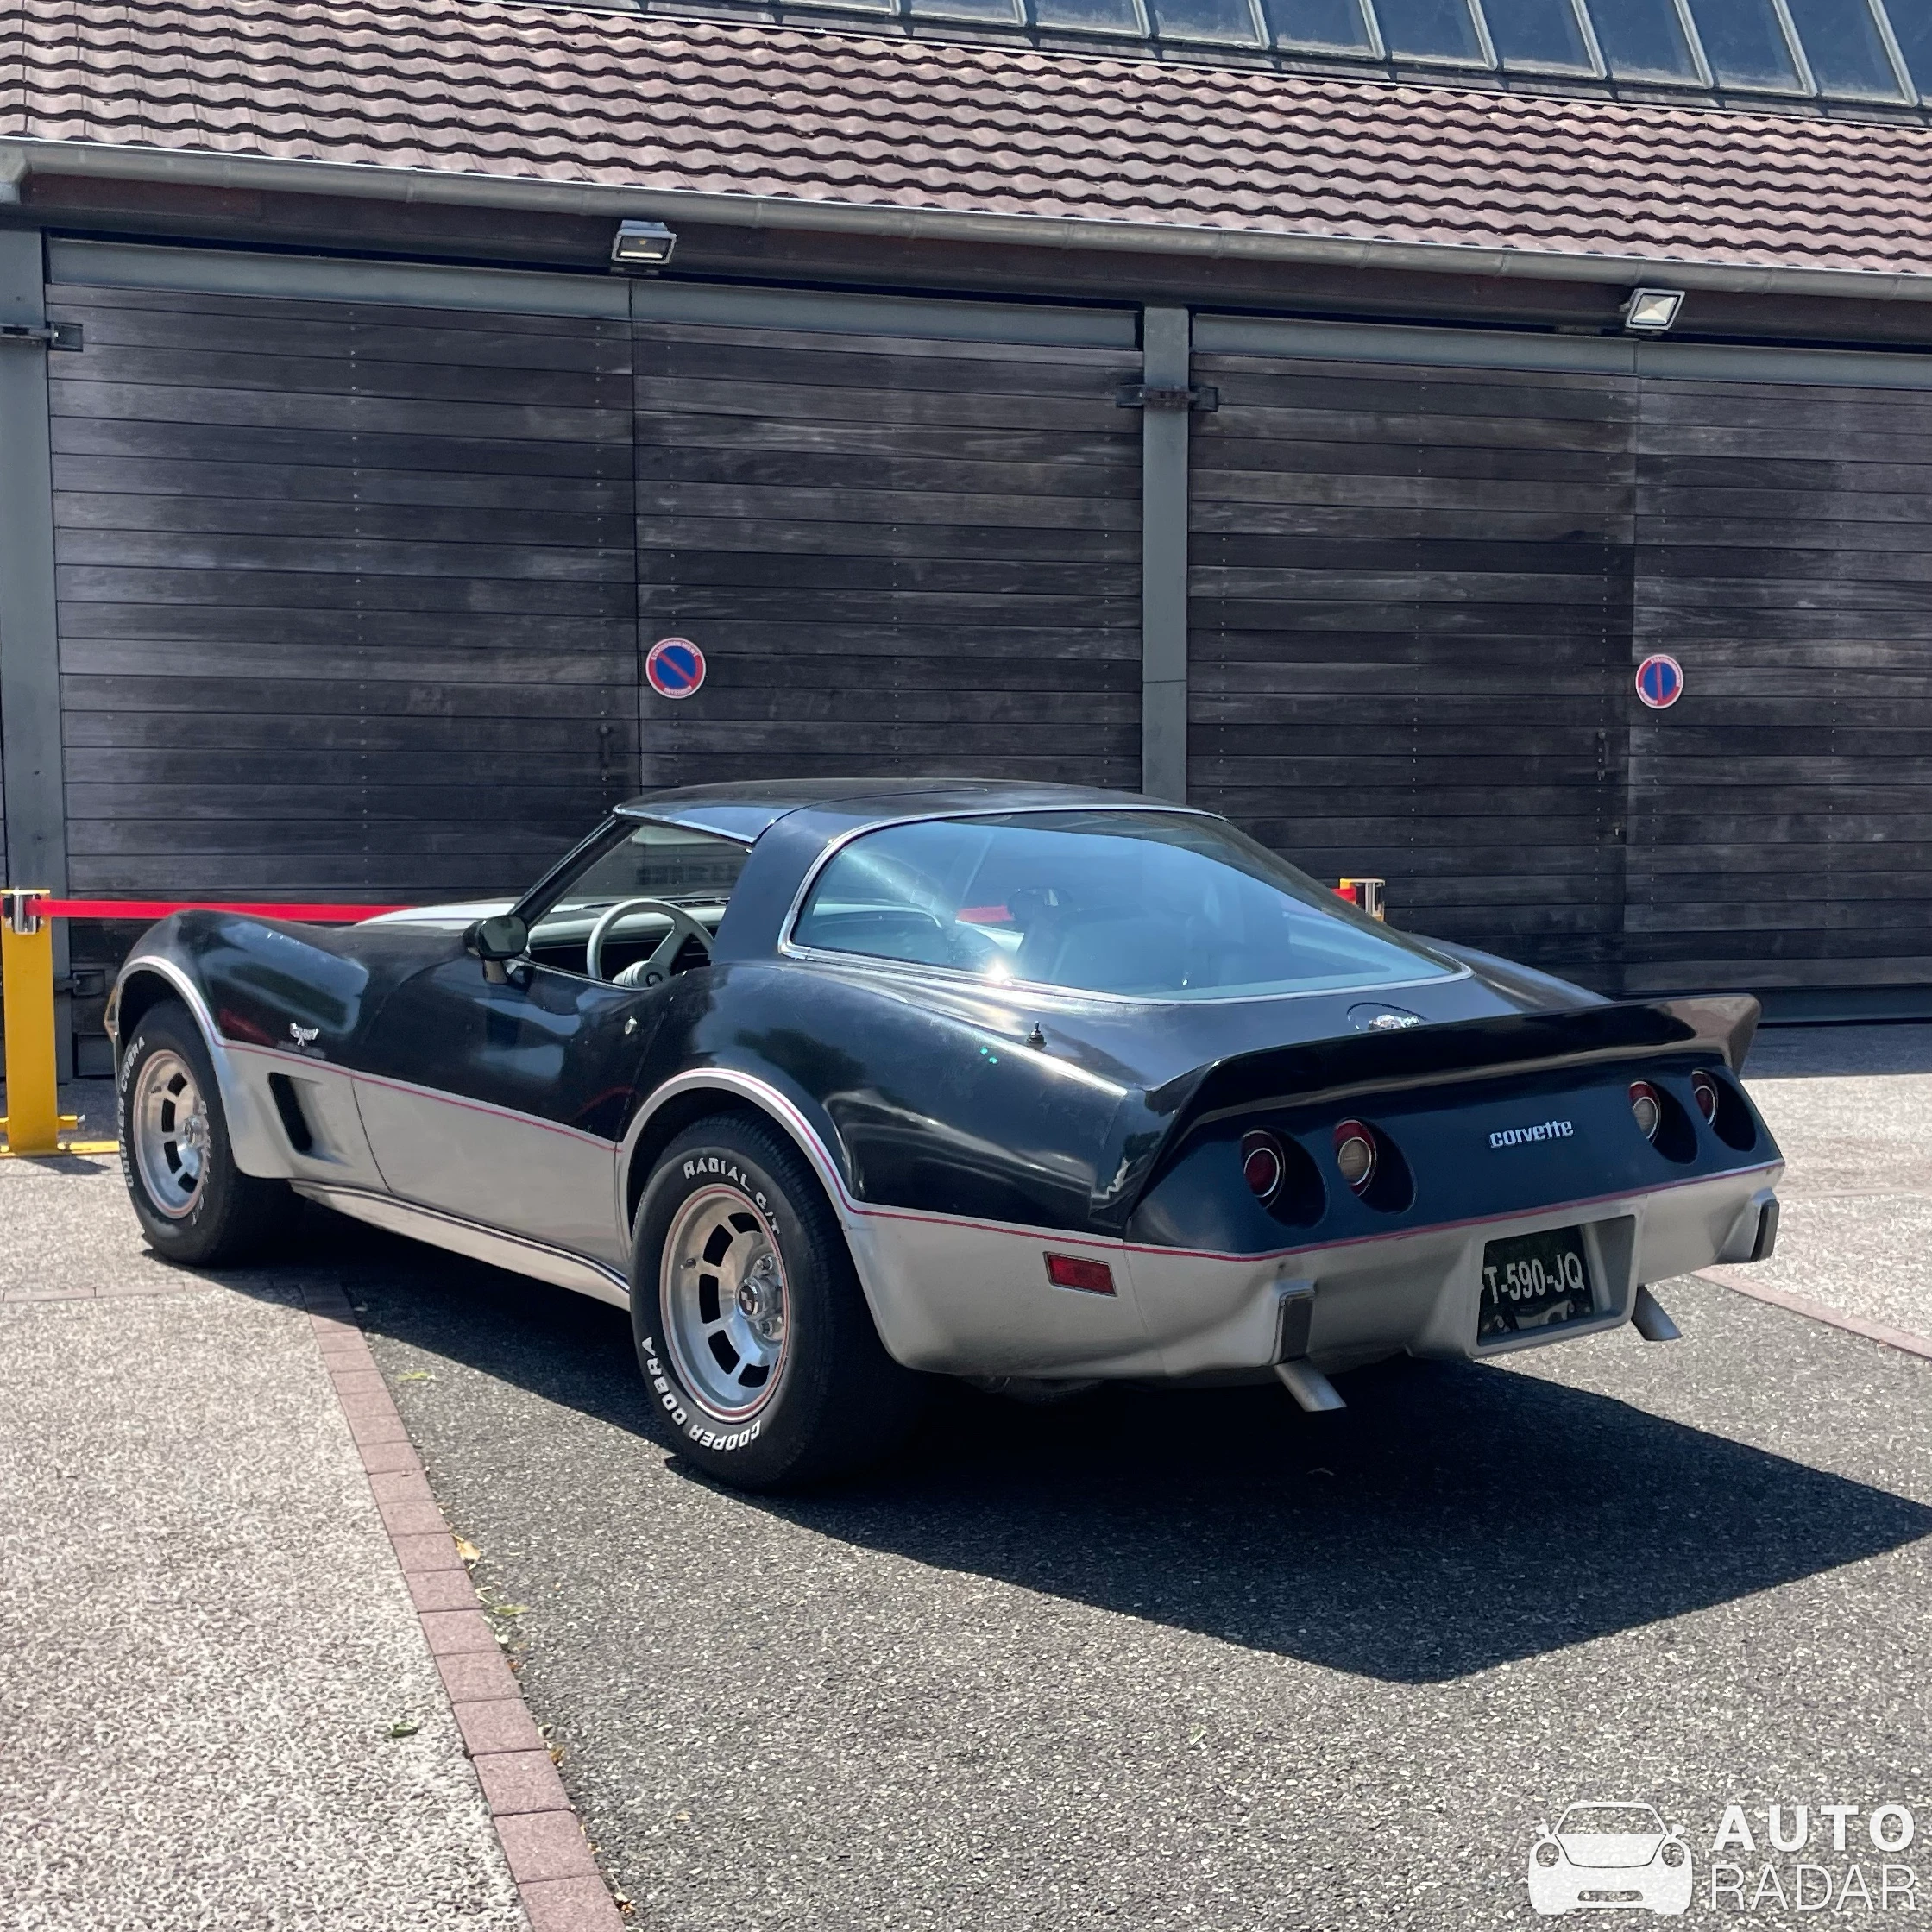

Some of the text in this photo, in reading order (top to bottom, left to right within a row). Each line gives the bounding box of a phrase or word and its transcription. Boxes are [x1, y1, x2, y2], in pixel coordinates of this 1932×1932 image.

[121, 1036, 145, 1092] COBRA
[1489, 1120, 1574, 1149] corvette
[683, 1157, 751, 1192] RADIAL
[641, 1337, 761, 1451] COOPER COBRA
